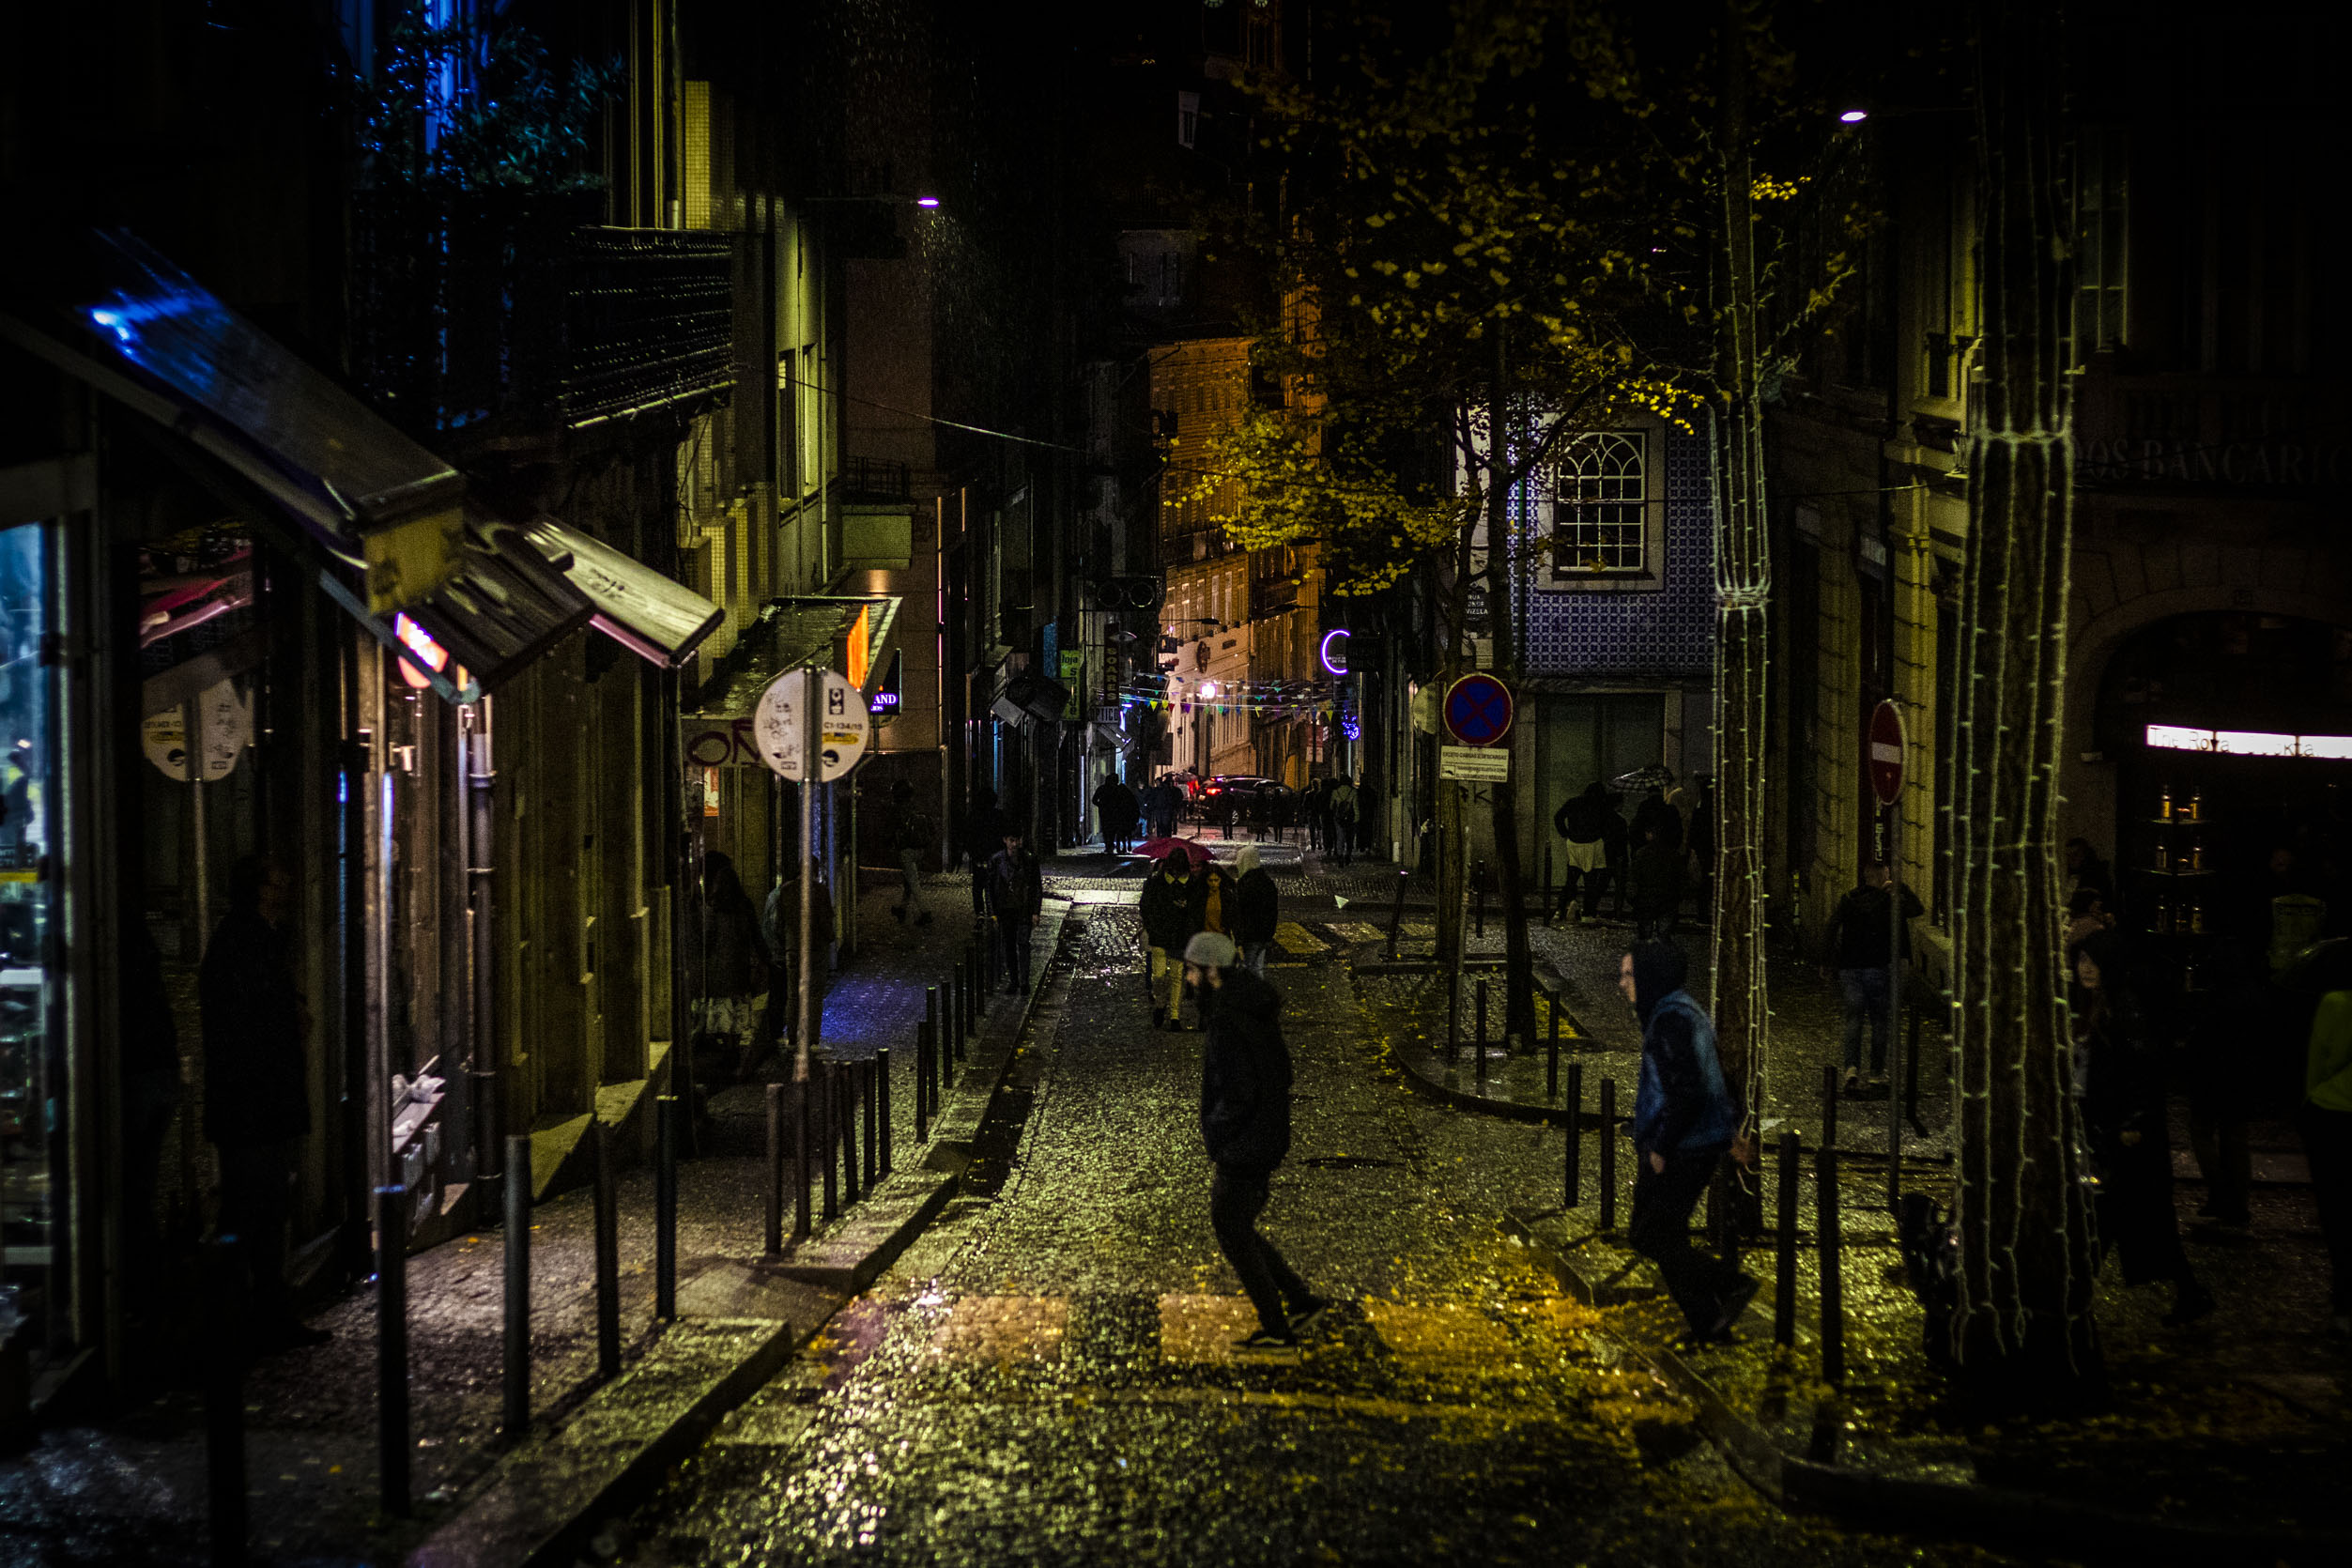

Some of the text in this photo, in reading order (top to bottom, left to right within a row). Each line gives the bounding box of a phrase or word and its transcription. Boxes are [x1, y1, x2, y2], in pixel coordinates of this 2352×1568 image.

[1061, 653, 1078, 665] loja
[874, 694, 897, 704] AND
[2189, 731, 2233, 753] Roya
